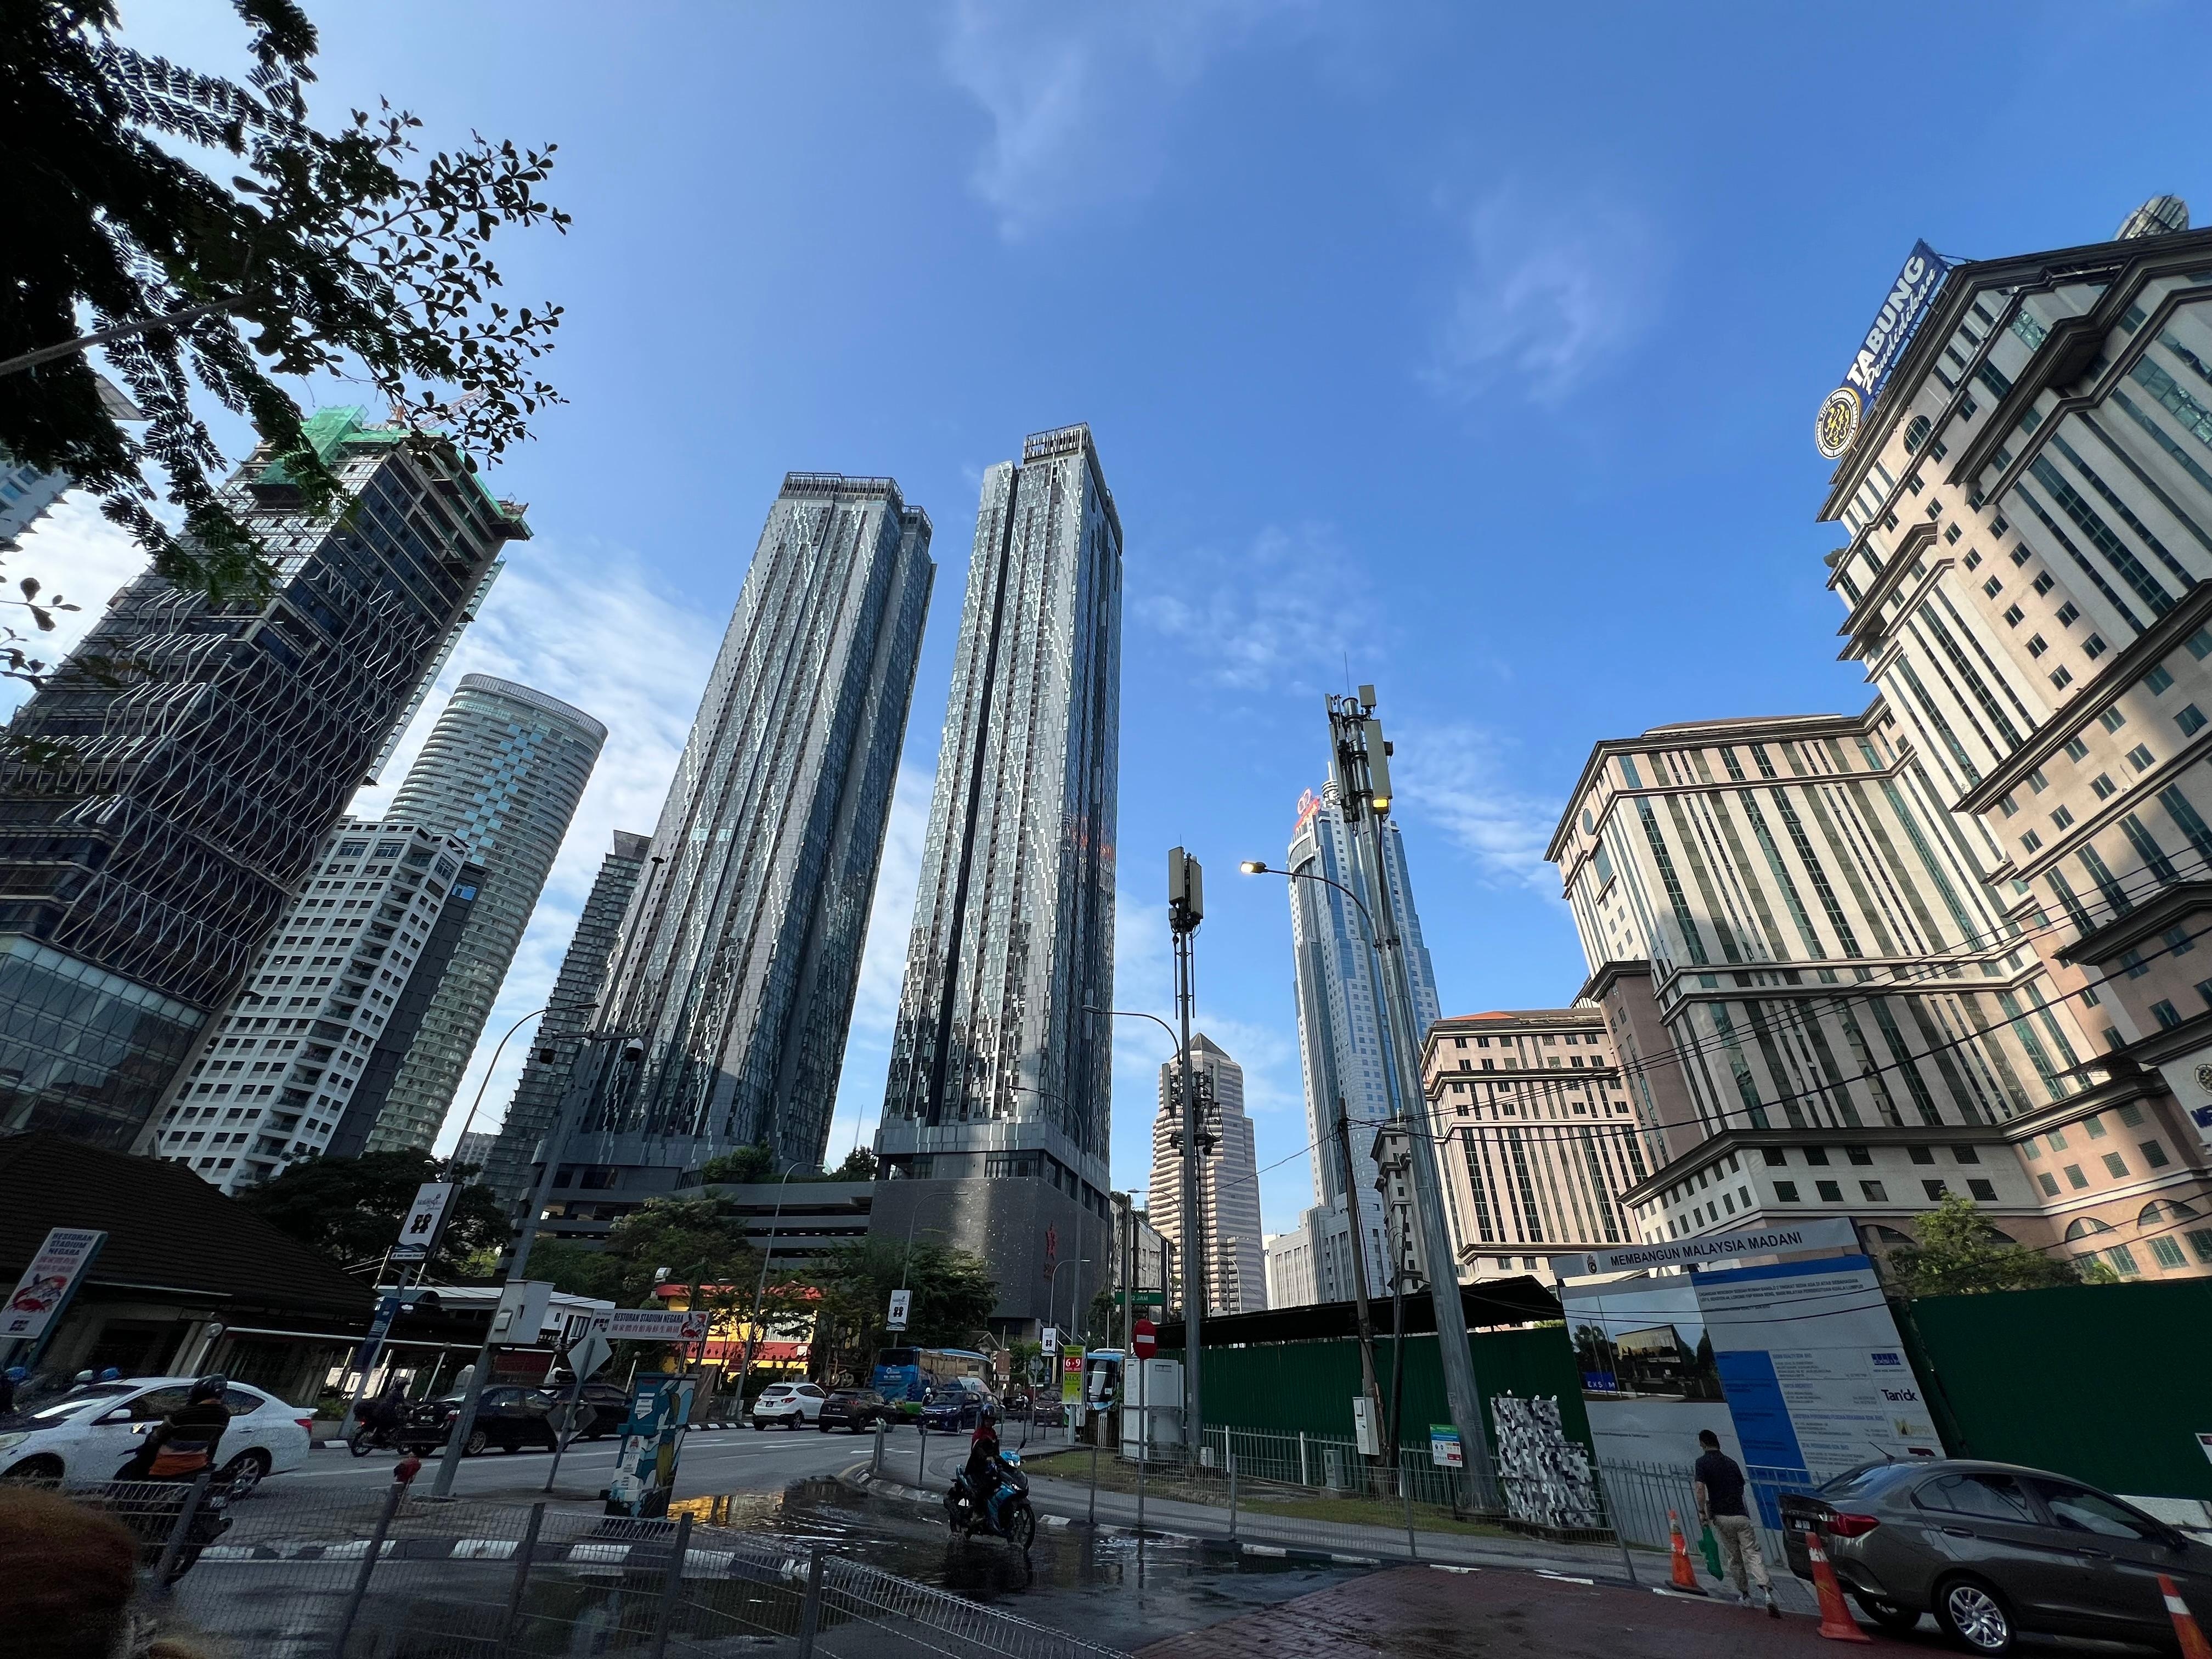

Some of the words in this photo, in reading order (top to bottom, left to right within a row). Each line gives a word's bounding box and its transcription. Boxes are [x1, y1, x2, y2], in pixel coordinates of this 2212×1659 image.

[1847, 256, 1925, 386] TABUNG
[1862, 269, 1936, 395] Pendidikan
[52, 1233, 94, 1241] RESTORAN
[1610, 1248, 1680, 1266] MEMBANGUN
[1682, 1238, 1747, 1258] MALAYSIA
[1747, 1232, 1803, 1249] MADANI
[613, 1313, 640, 1322] RESTORAN
[640, 1314, 663, 1322] STADIUM
[663, 1314, 684, 1323] NEGARA
